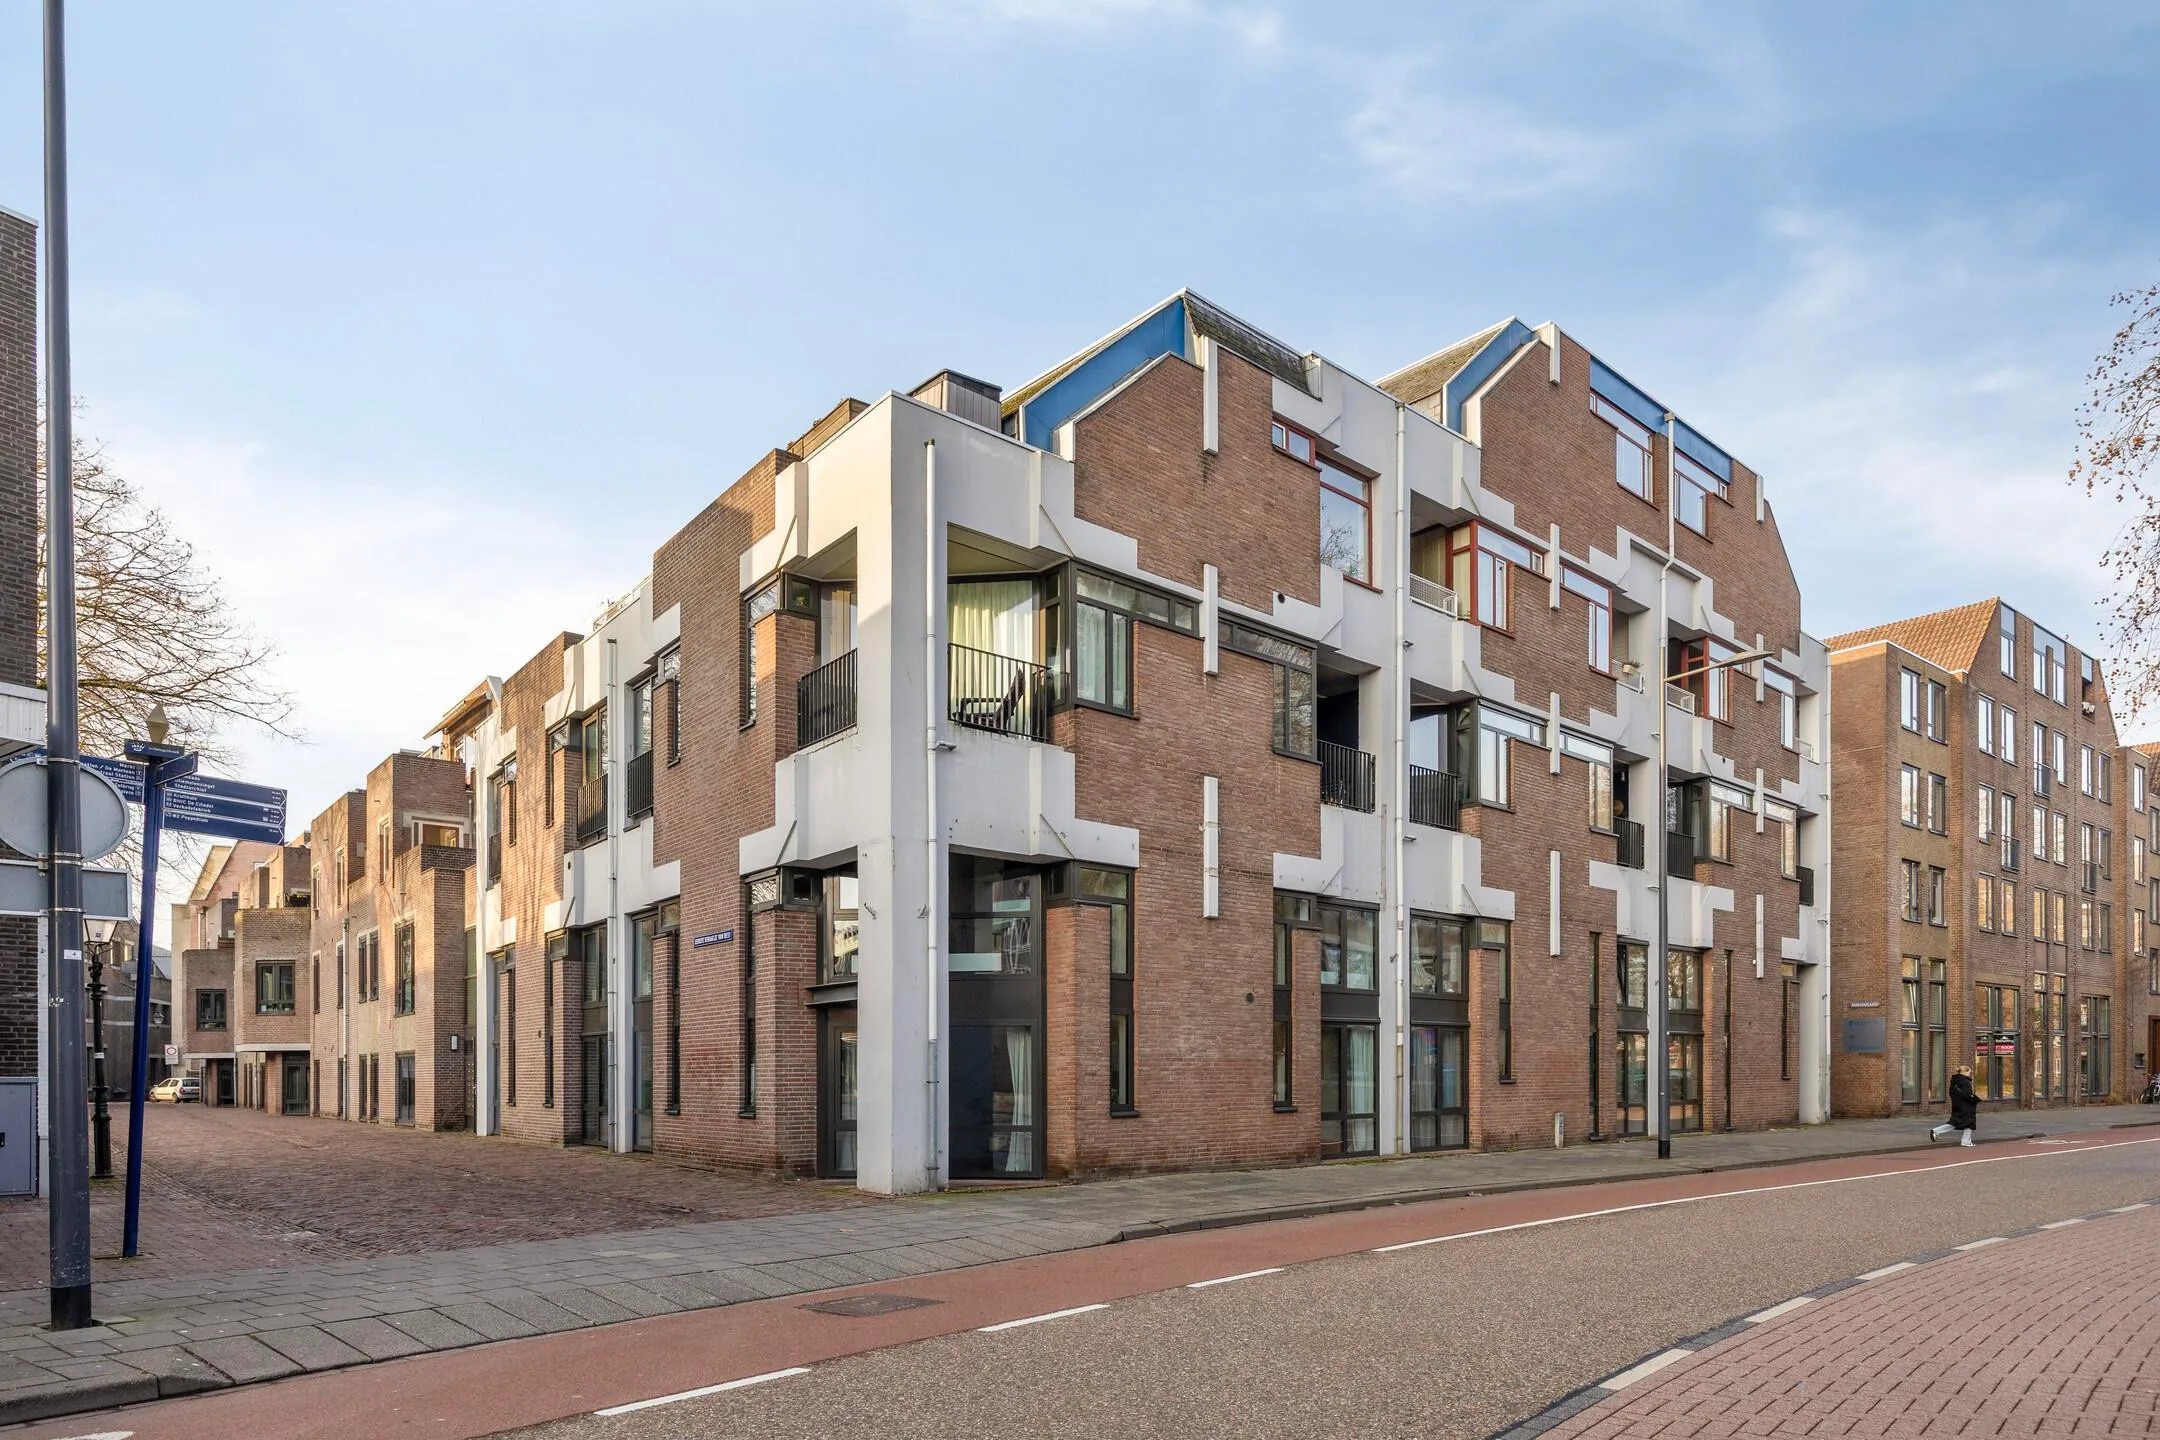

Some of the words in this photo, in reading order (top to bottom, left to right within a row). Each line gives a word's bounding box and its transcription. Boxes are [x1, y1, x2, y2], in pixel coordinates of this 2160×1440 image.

[119, 762, 136, 770] Markt
[114, 772, 135, 780] Station
[174, 783, 207, 793] Stadsarchief
